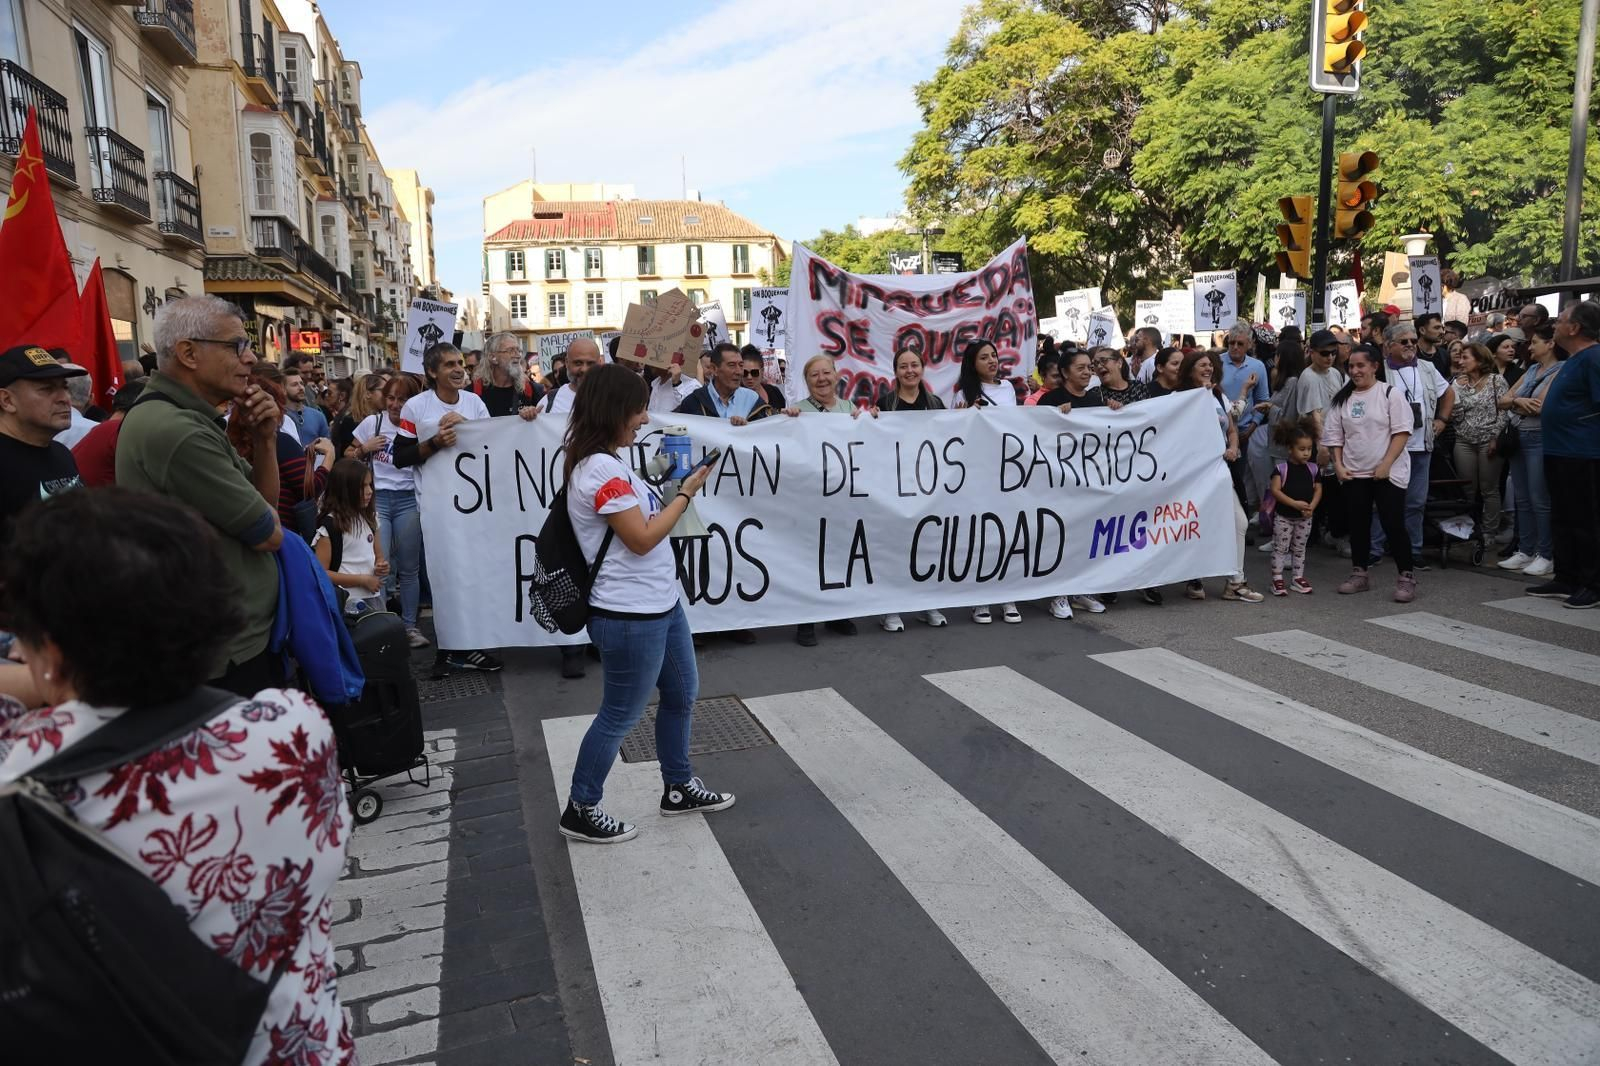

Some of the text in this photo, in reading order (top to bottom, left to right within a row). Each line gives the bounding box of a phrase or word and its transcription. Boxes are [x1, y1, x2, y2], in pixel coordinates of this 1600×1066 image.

[822, 441, 869, 498] DE
[896, 437, 966, 497] LOS
[1147, 521, 1201, 545] VIVIR
[1154, 500, 1198, 525] PARA
[819, 517, 874, 591] LA
[909, 507, 1065, 583] CIUDAD
[1089, 511, 1148, 560] MLG
